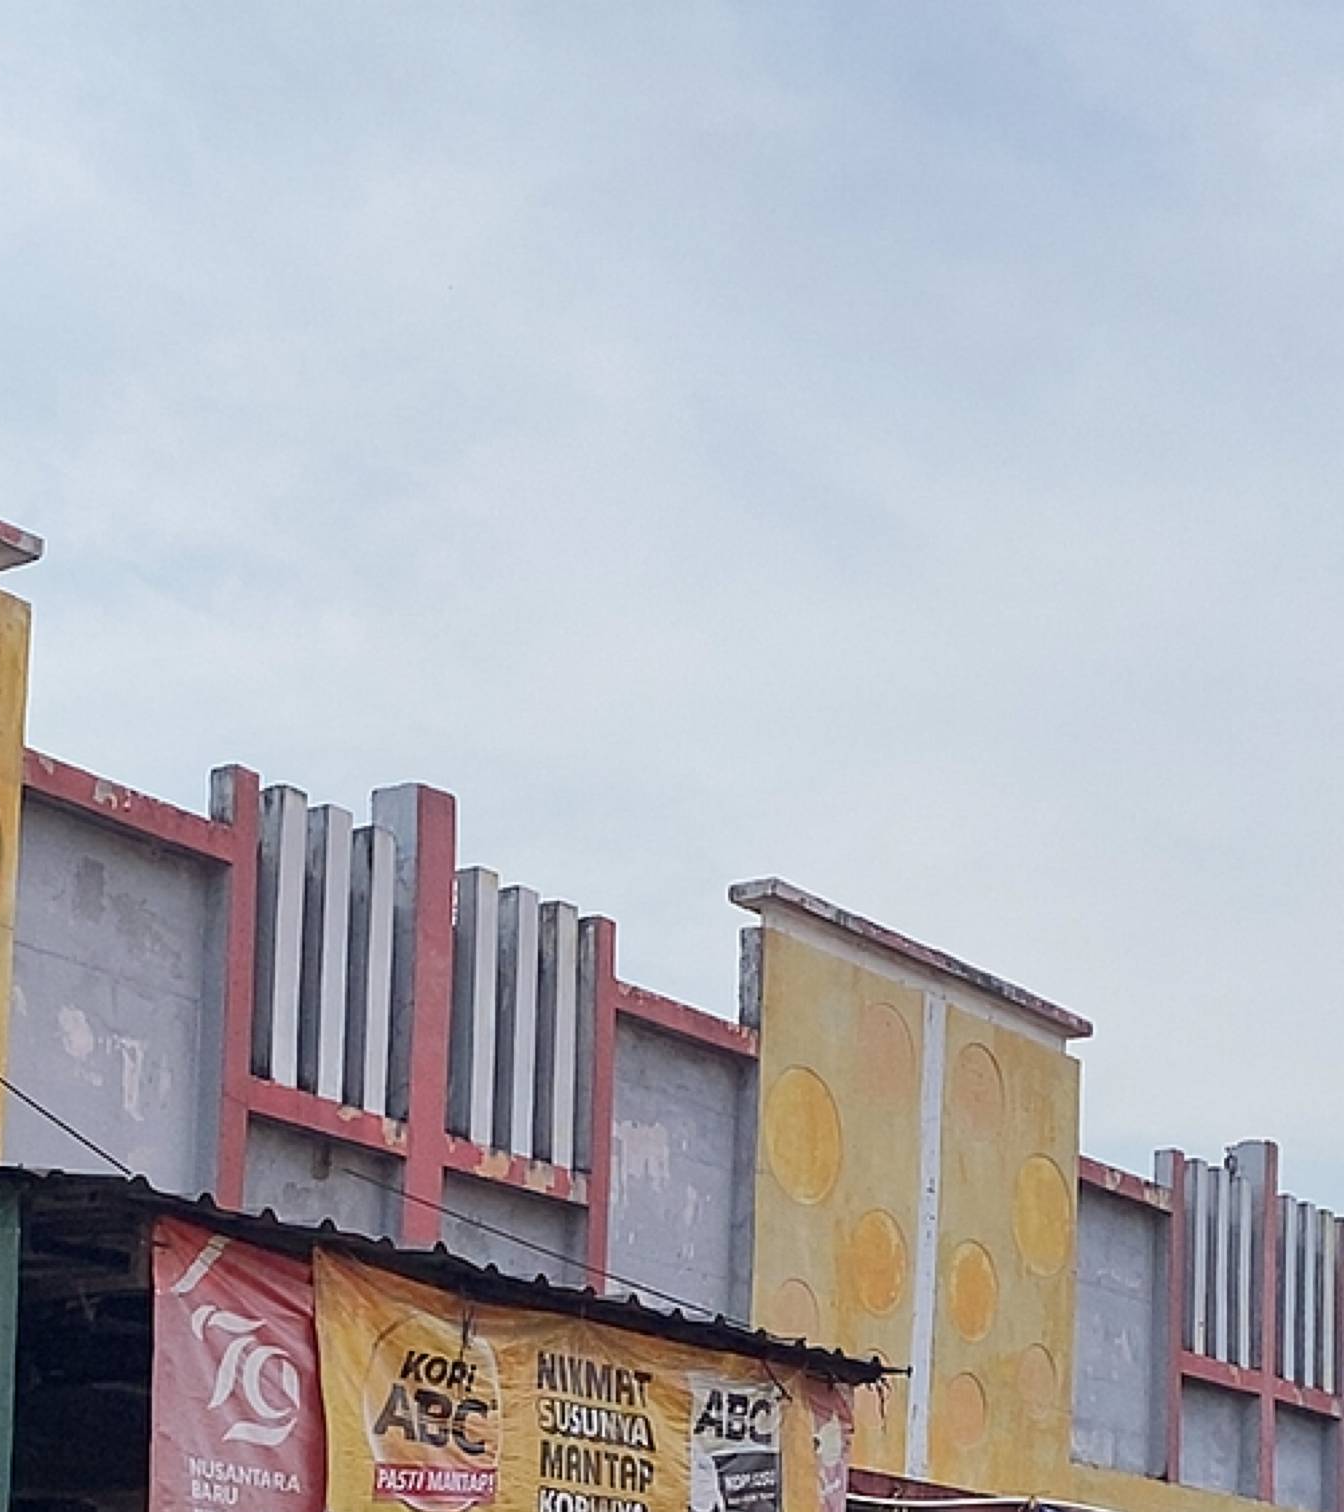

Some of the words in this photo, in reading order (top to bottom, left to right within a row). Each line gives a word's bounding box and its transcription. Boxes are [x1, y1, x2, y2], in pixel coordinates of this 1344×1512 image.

[537, 1350, 654, 1408] NIKMAT
[373, 1382, 489, 1456] ABC
[537, 1398, 655, 1451] SUSUNYA
[692, 1389, 773, 1444] ABC
[188, 1457, 301, 1494] NUSANTARA
[191, 1479, 239, 1505] BARU
[540, 1439, 655, 1494] MANTAP
